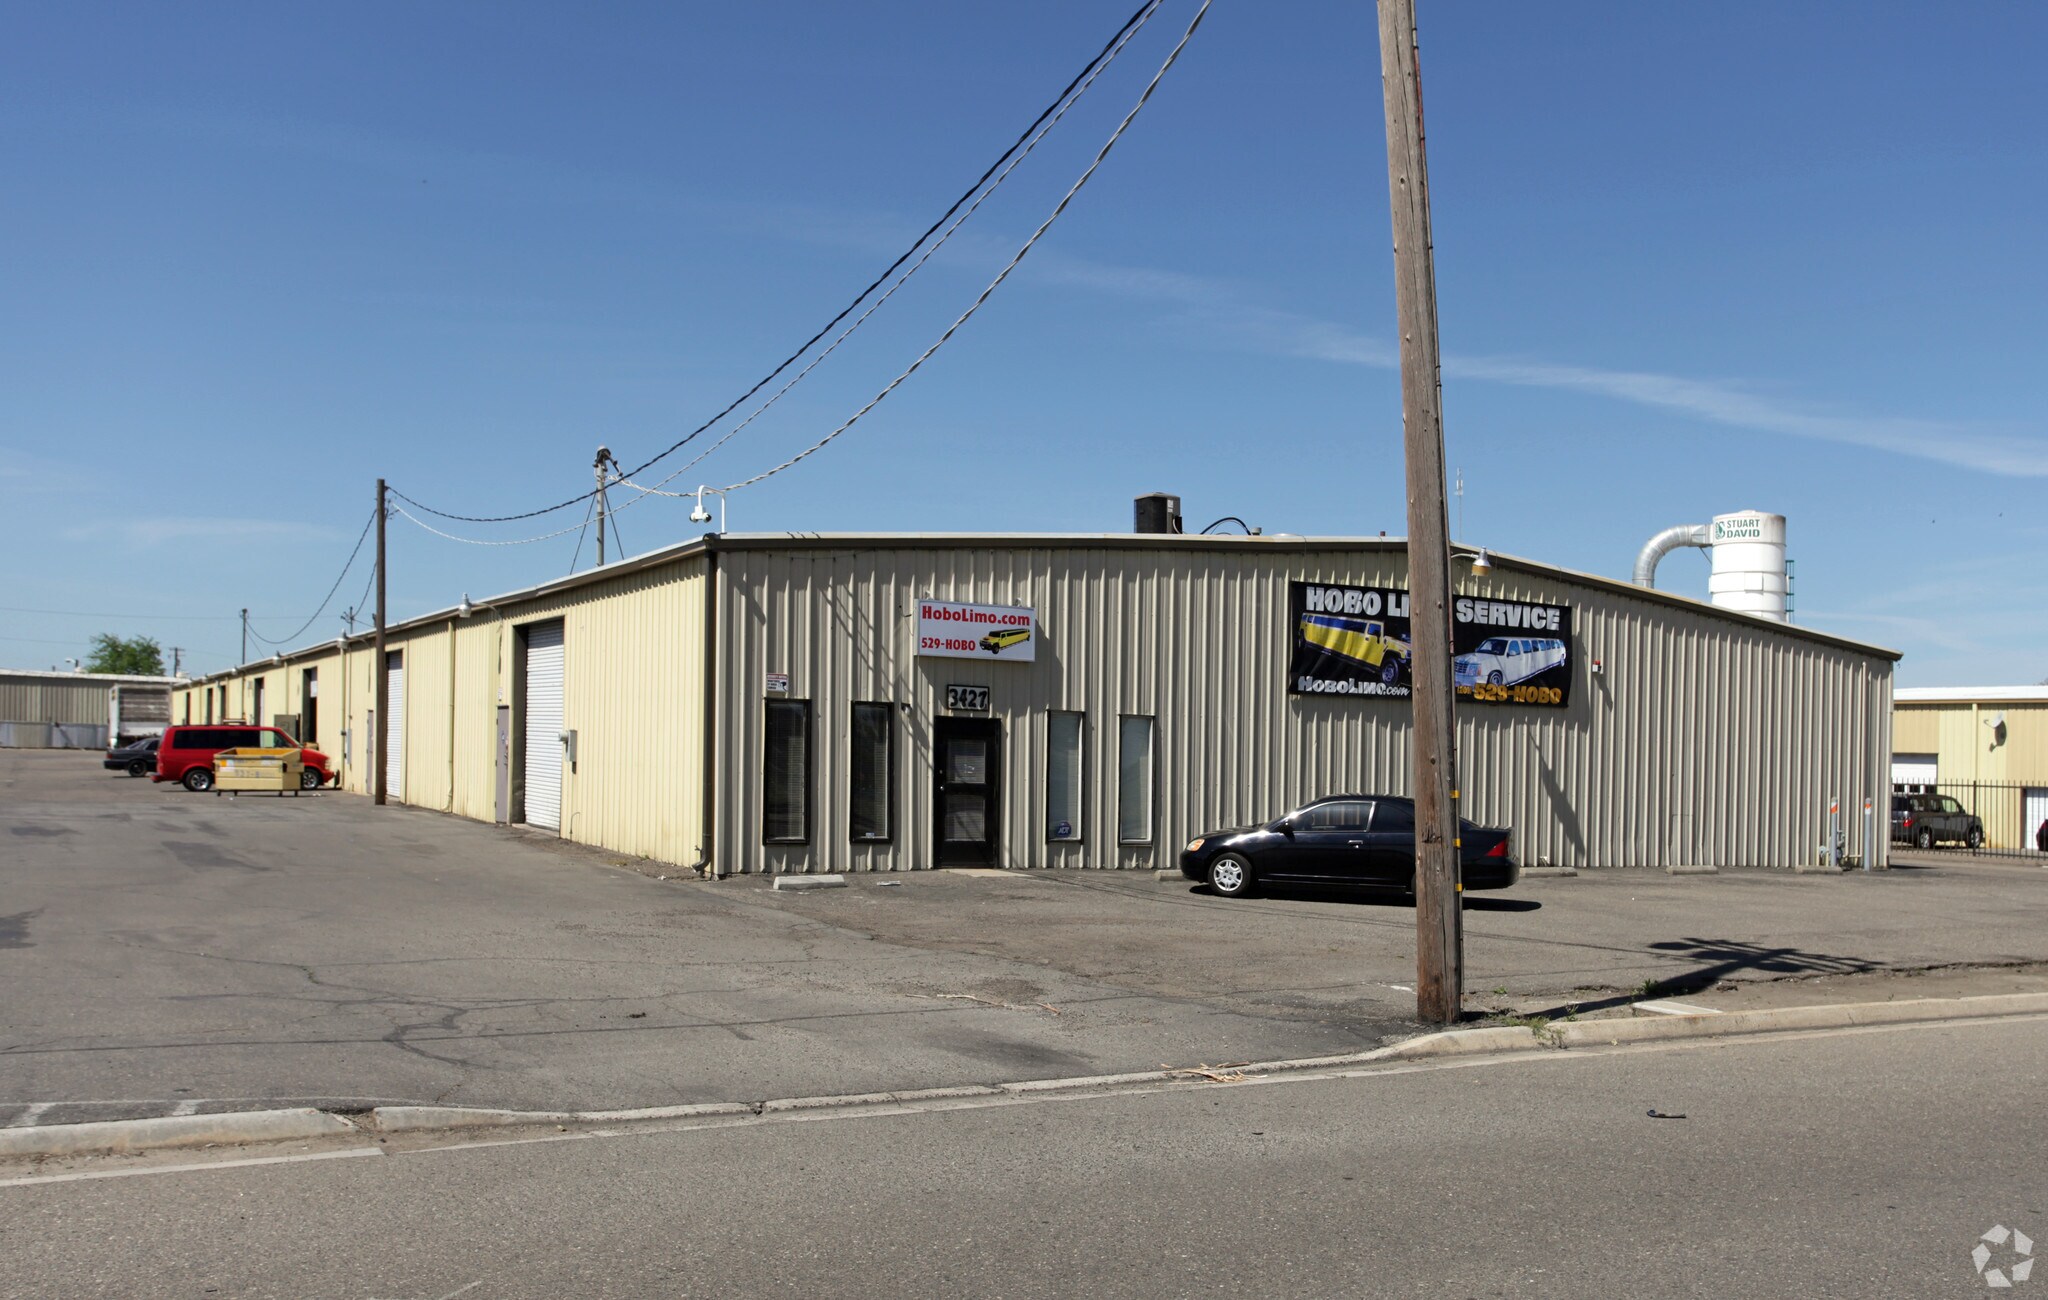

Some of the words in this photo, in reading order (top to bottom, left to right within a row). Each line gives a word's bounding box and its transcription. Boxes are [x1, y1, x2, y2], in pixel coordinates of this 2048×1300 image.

[1726, 519, 1760, 529] STUART
[1726, 529, 1760, 538] DAVID
[922, 605, 1031, 626] HoboLimo.com
[1306, 586, 1382, 616] HOBO
[1387, 592, 1410, 618] LI
[1456, 598, 1560, 631] SERVICE
[921, 637, 976, 651] 529-HOBO
[949, 688, 988, 708] 3427
[1473, 682, 1562, 704] 529-HOBO
